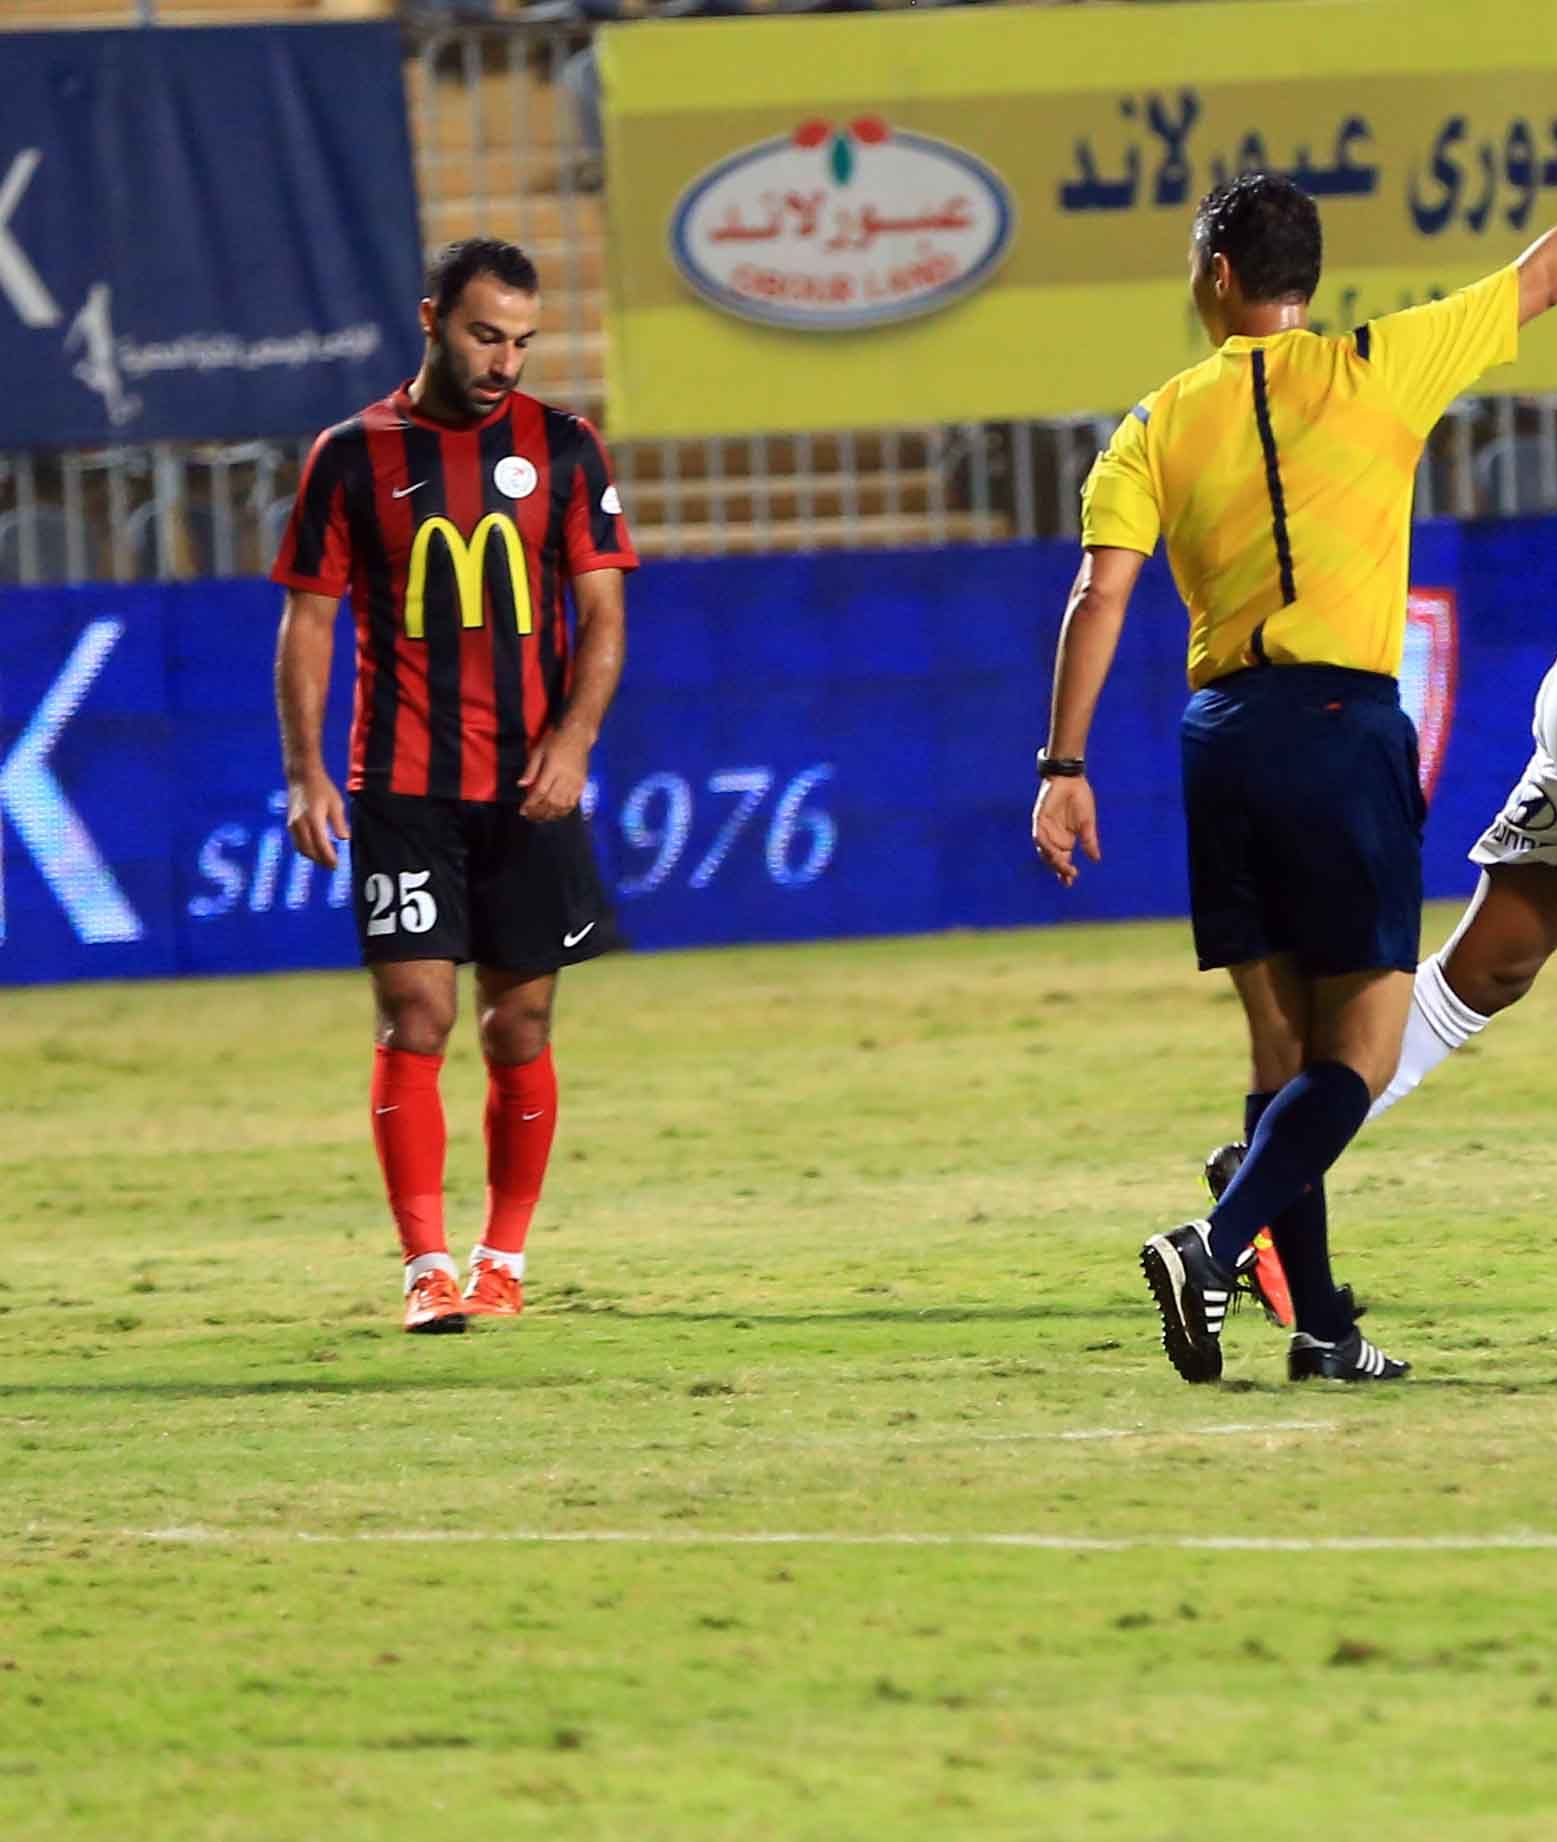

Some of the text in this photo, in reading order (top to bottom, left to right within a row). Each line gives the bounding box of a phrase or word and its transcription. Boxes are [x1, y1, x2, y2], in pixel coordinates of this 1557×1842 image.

[1057, 90, 1377, 210] عبلاند
[580, 764, 838, 898] 976
[365, 870, 438, 936] 25
